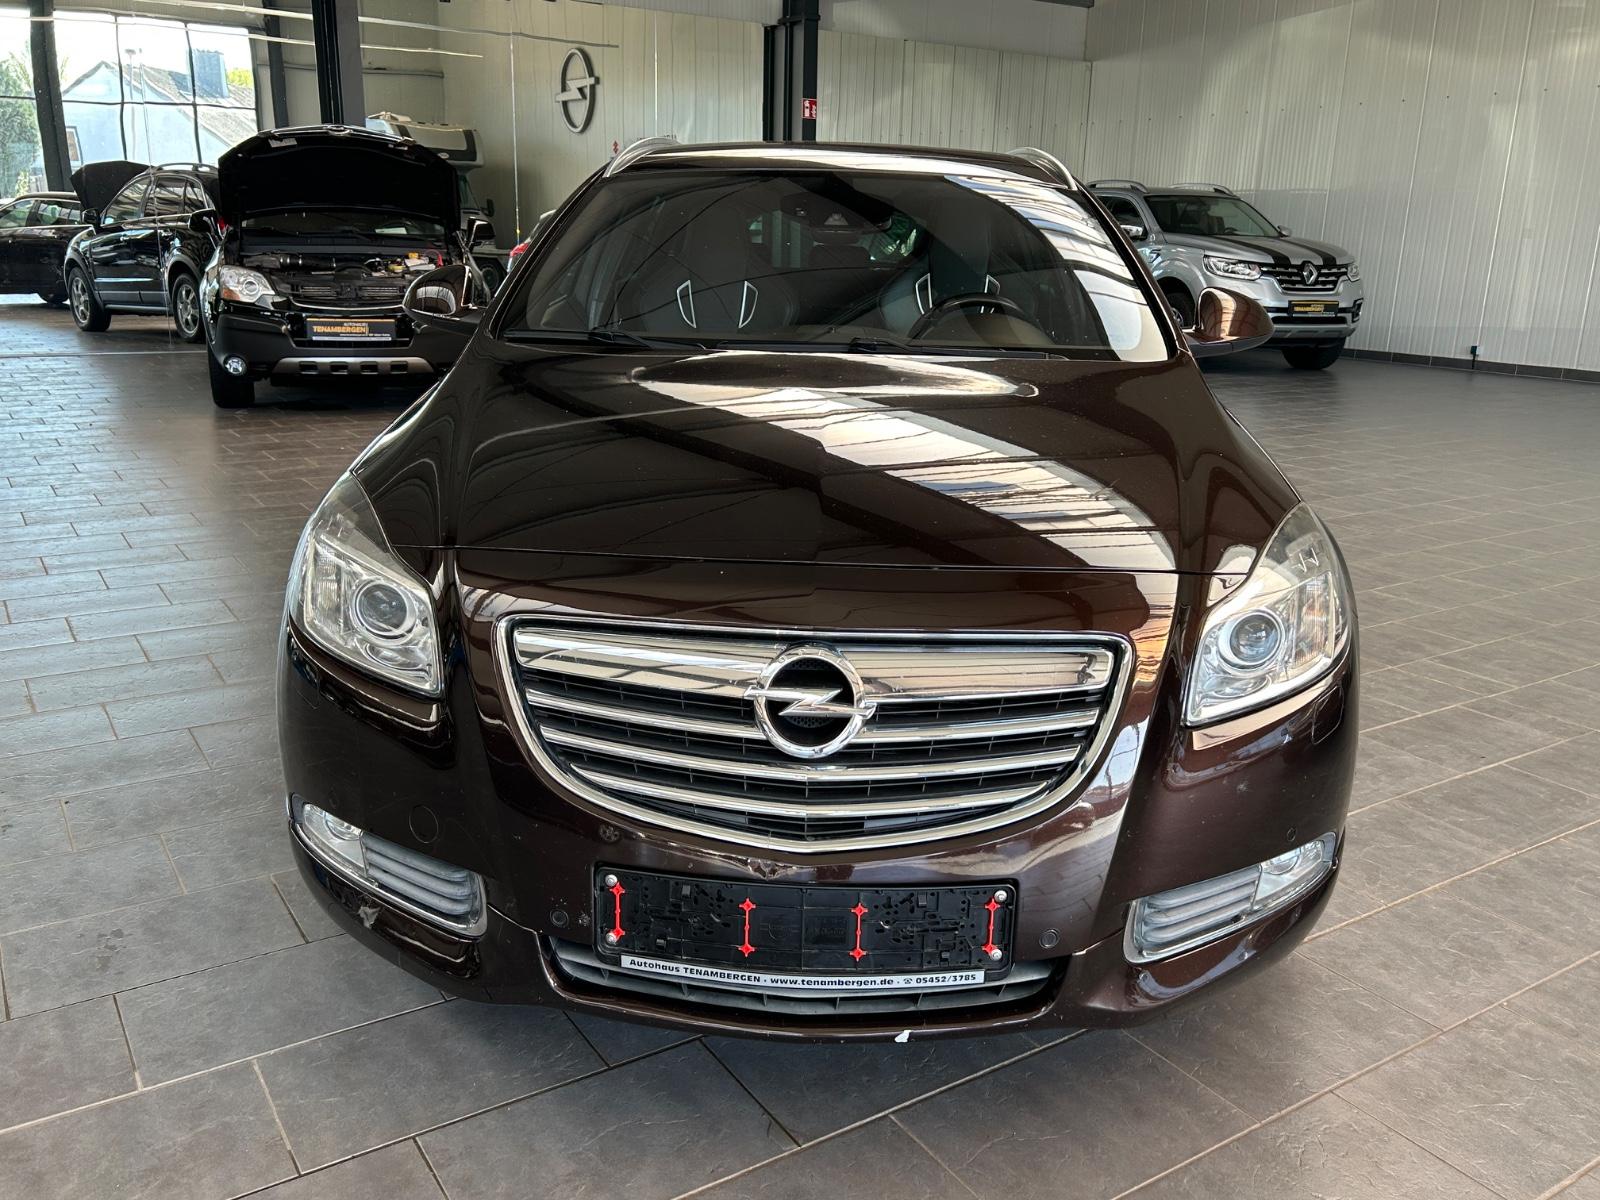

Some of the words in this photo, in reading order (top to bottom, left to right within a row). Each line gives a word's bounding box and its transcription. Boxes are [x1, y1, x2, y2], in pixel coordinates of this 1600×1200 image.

[629, 959, 680, 972] Autohaus
[683, 967, 760, 983] TENAMBERGEN
[770, 978, 894, 988] www.tenambergen.de
[915, 974, 976, 984] 05452/3785
